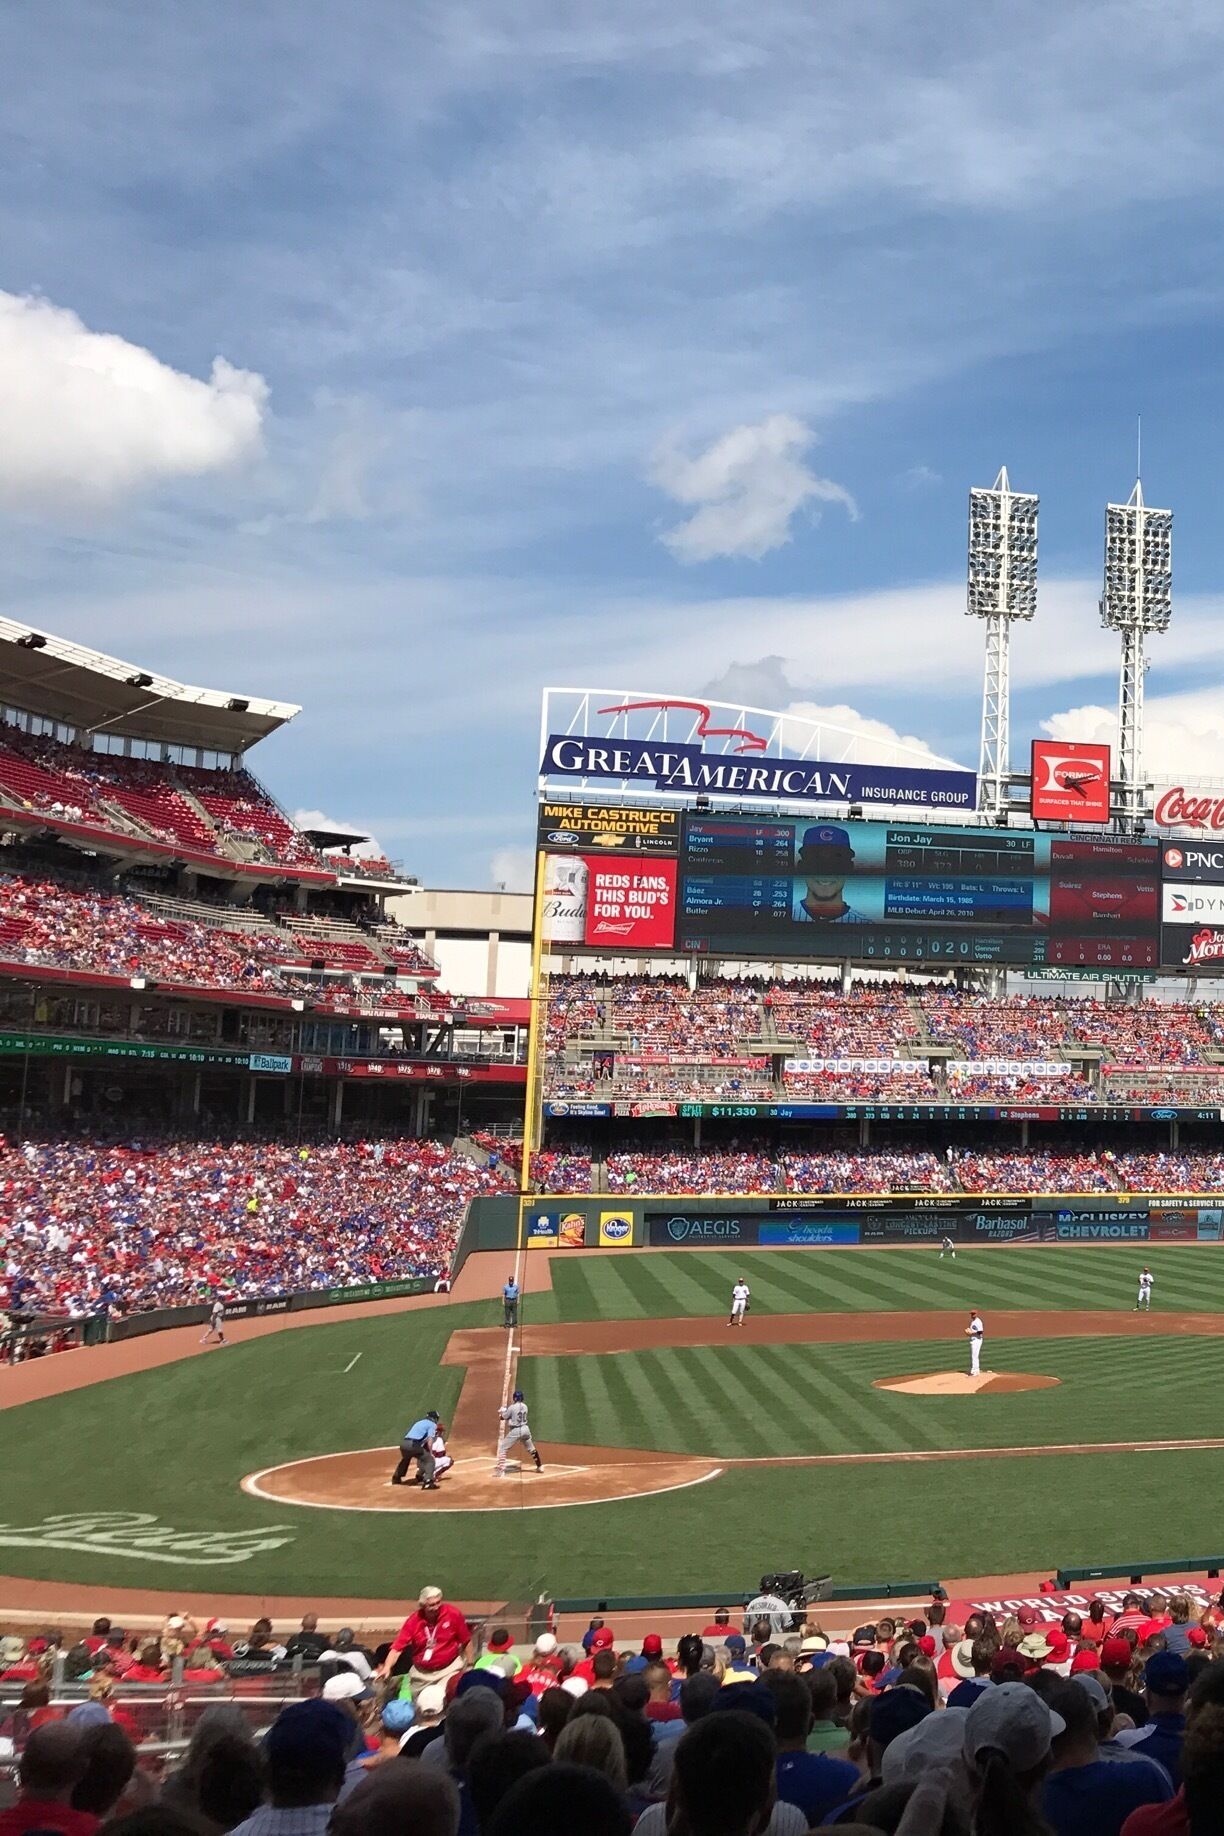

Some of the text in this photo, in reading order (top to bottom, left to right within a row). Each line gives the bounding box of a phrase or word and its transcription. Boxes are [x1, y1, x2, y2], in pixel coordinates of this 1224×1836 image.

[552, 740, 848, 796] GREAT AMERICAN
[862, 787, 969, 804] INSURANCE GROUP
[544, 806, 675, 823] MIKE CASTRUCCI
[560, 819, 659, 834] AUTOMOTIVE
[552, 833, 572, 842] Ford
[689, 835, 714, 844] Bryant
[890, 834, 911, 843] Jon
[913, 835, 932, 846] Jay
[1070, 835, 1119, 844] CINCINNATI
[688, 846, 709, 854] Rizzo
[1093, 846, 1123, 854] Hamilton
[1185, 852, 1224, 869] PNC
[595, 874, 670, 891] REDS FANS,
[992, 885, 1019, 894] Throws:
[595, 889, 669, 905] THIS BUD'S
[888, 894, 945, 903] Birthdate: March
[1092, 891, 1123, 900] Stephens
[686, 897, 724, 906] Almora Jr.
[594, 904, 654, 919] FOR YOU.
[686, 907, 708, 915] Butler
[928, 908, 945, 917] April
[958, 910, 974, 918] 2010
[685, 940, 702, 949] CIN
[932, 941, 969, 954] 0 2 0
[975, 952, 993, 960] Votto
[1027, 971, 1150, 983] ULTIMATE AIR SHUTTLE
[415, 1013, 440, 1021] STAPLES
[142, 1050, 155, 1058] 7:15
[260, 1058, 289, 1071] Ballpark
[682, 1104, 703, 1112] SPLIT
[712, 1106, 757, 1117] $11,330
[780, 1109, 793, 1117] Jay
[1010, 1111, 1040, 1120] Stephens
[1156, 1111, 1173, 1119] Ford
[776, 1200, 798, 1208] JACK
[846, 1200, 868, 1208] JACK
[914, 1199, 935, 1207] JACK
[1189, 1200, 1214, 1208] SERVICE
[561, 1217, 585, 1233] Kahn's
[976, 1215, 1028, 1230] Barbasol
[606, 1221, 629, 1236] Kroger
[690, 1220, 741, 1235] AEGIS
[1058, 1225, 1148, 1237] CHEVROLET
[787, 1234, 833, 1243] shoulders
[226, 1305, 247, 1315] RAM
[266, 1301, 287, 1310] RAM
[970, 1594, 1089, 1614] WORLD
[1094, 1583, 1208, 1605] SERIES
